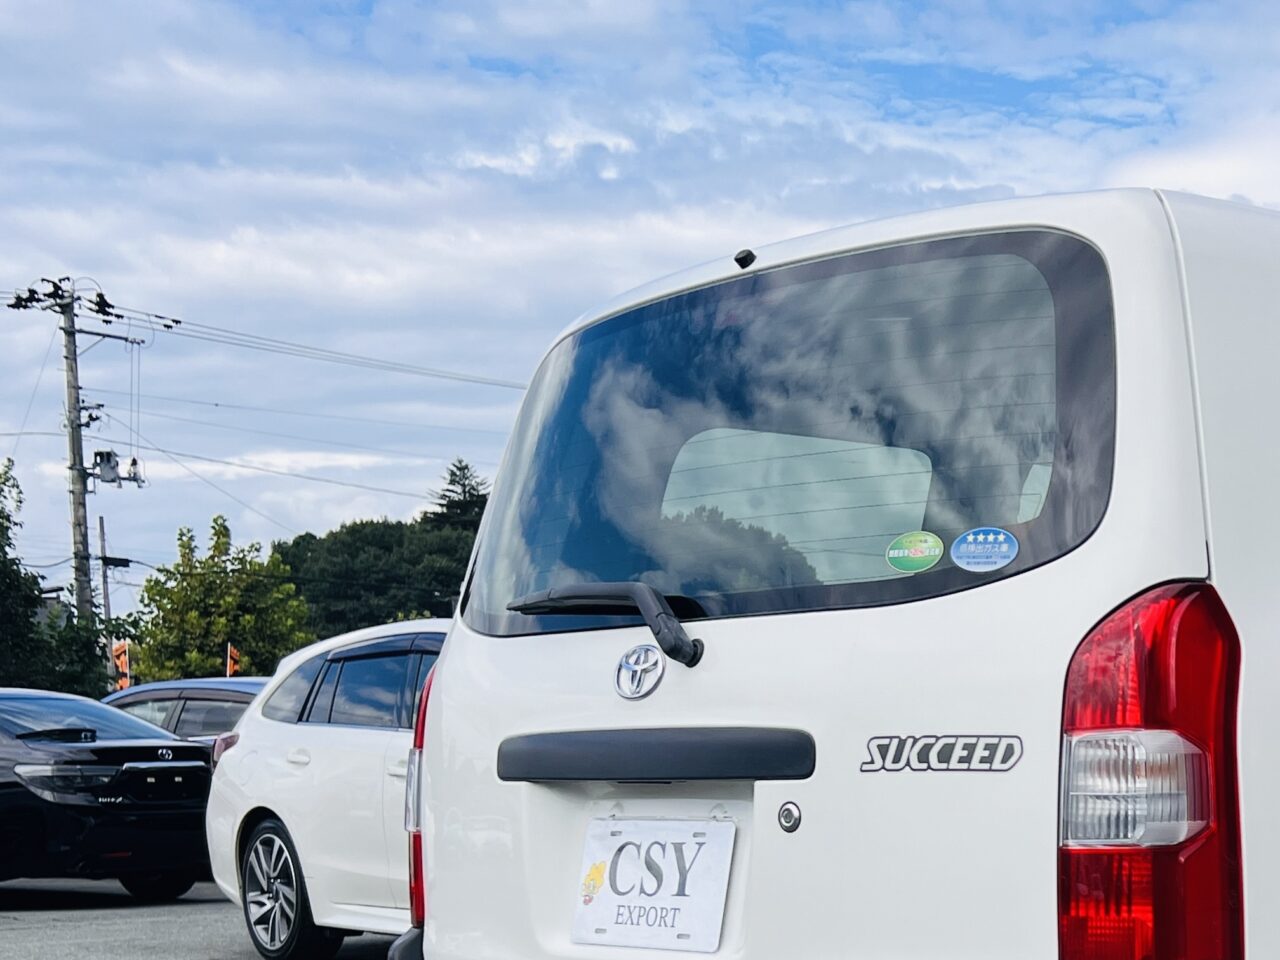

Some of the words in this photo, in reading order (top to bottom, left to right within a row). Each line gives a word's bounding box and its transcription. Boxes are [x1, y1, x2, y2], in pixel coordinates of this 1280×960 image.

[860, 735, 1024, 772] SUCCEED
[608, 840, 706, 897] CSY
[614, 904, 681, 928] EXPORT
